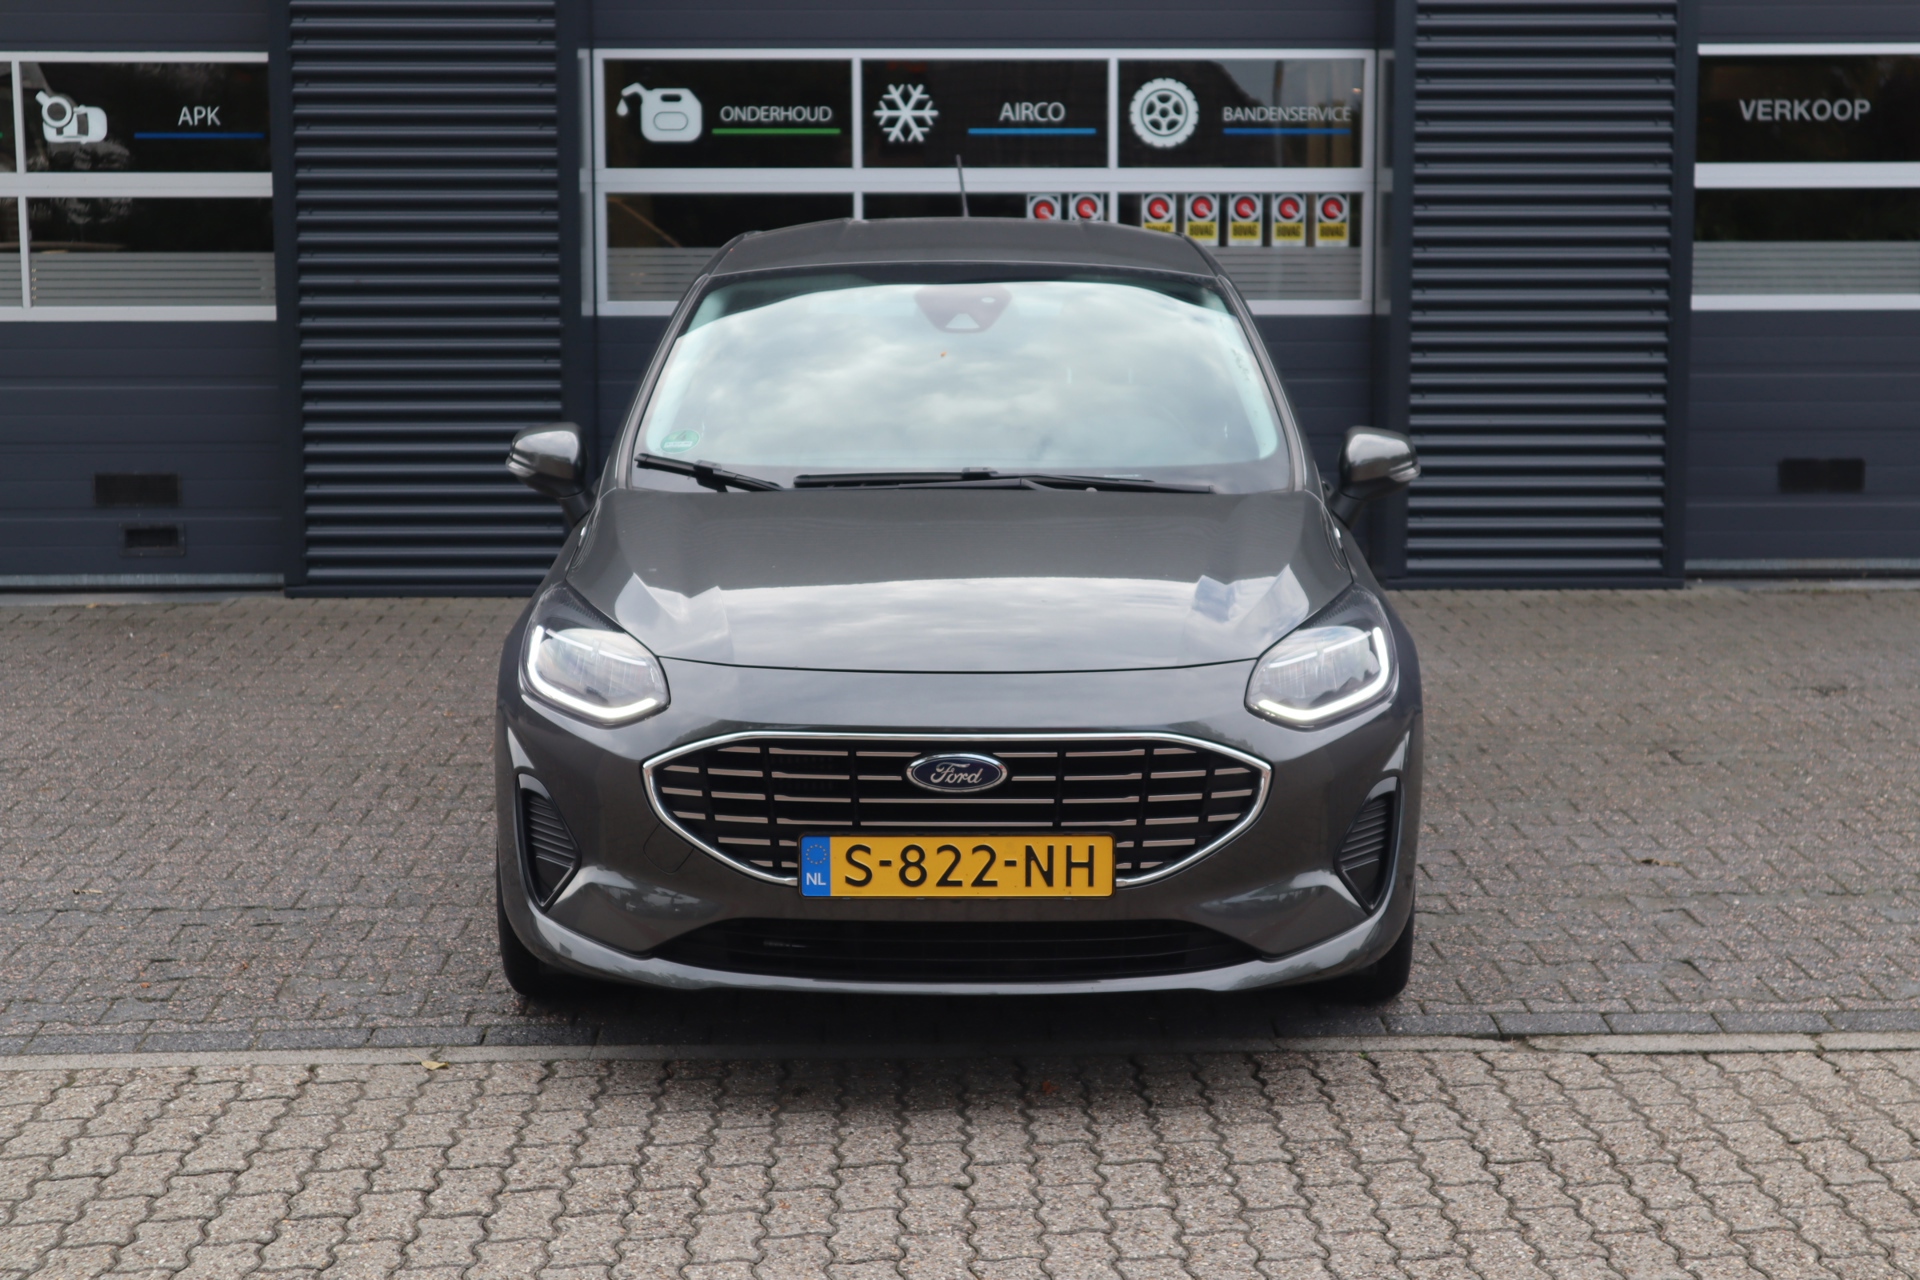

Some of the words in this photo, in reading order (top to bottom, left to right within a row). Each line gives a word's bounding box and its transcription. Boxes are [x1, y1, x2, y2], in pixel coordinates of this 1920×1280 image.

[178, 105, 221, 126] APK
[720, 105, 832, 122] ONDERHOUD
[999, 102, 1066, 121] AIRCO
[1222, 106, 1352, 122] BANDENSERVICE
[1738, 98, 1872, 121] VERKOOP
[930, 761, 985, 784] Ford
[844, 843, 1095, 888] S-822-NH
[806, 872, 826, 886] NL
